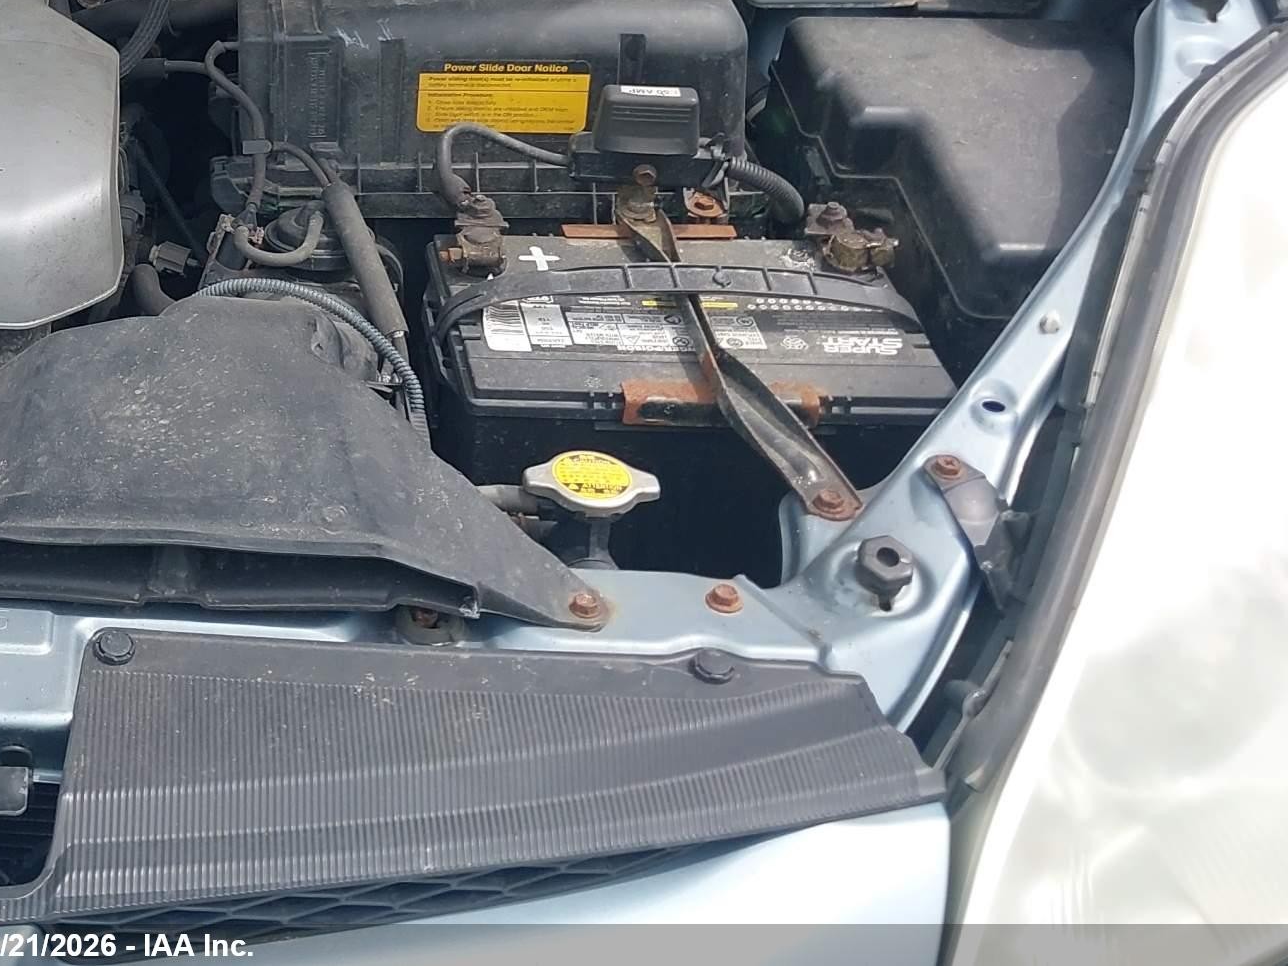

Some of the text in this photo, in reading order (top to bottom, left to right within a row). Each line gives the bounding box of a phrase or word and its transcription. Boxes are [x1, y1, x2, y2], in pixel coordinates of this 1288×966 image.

[444, 63, 569, 73] Power Slide Door Notice
[821, 337, 904, 349] START
[823, 345, 899, 356] SUPER
